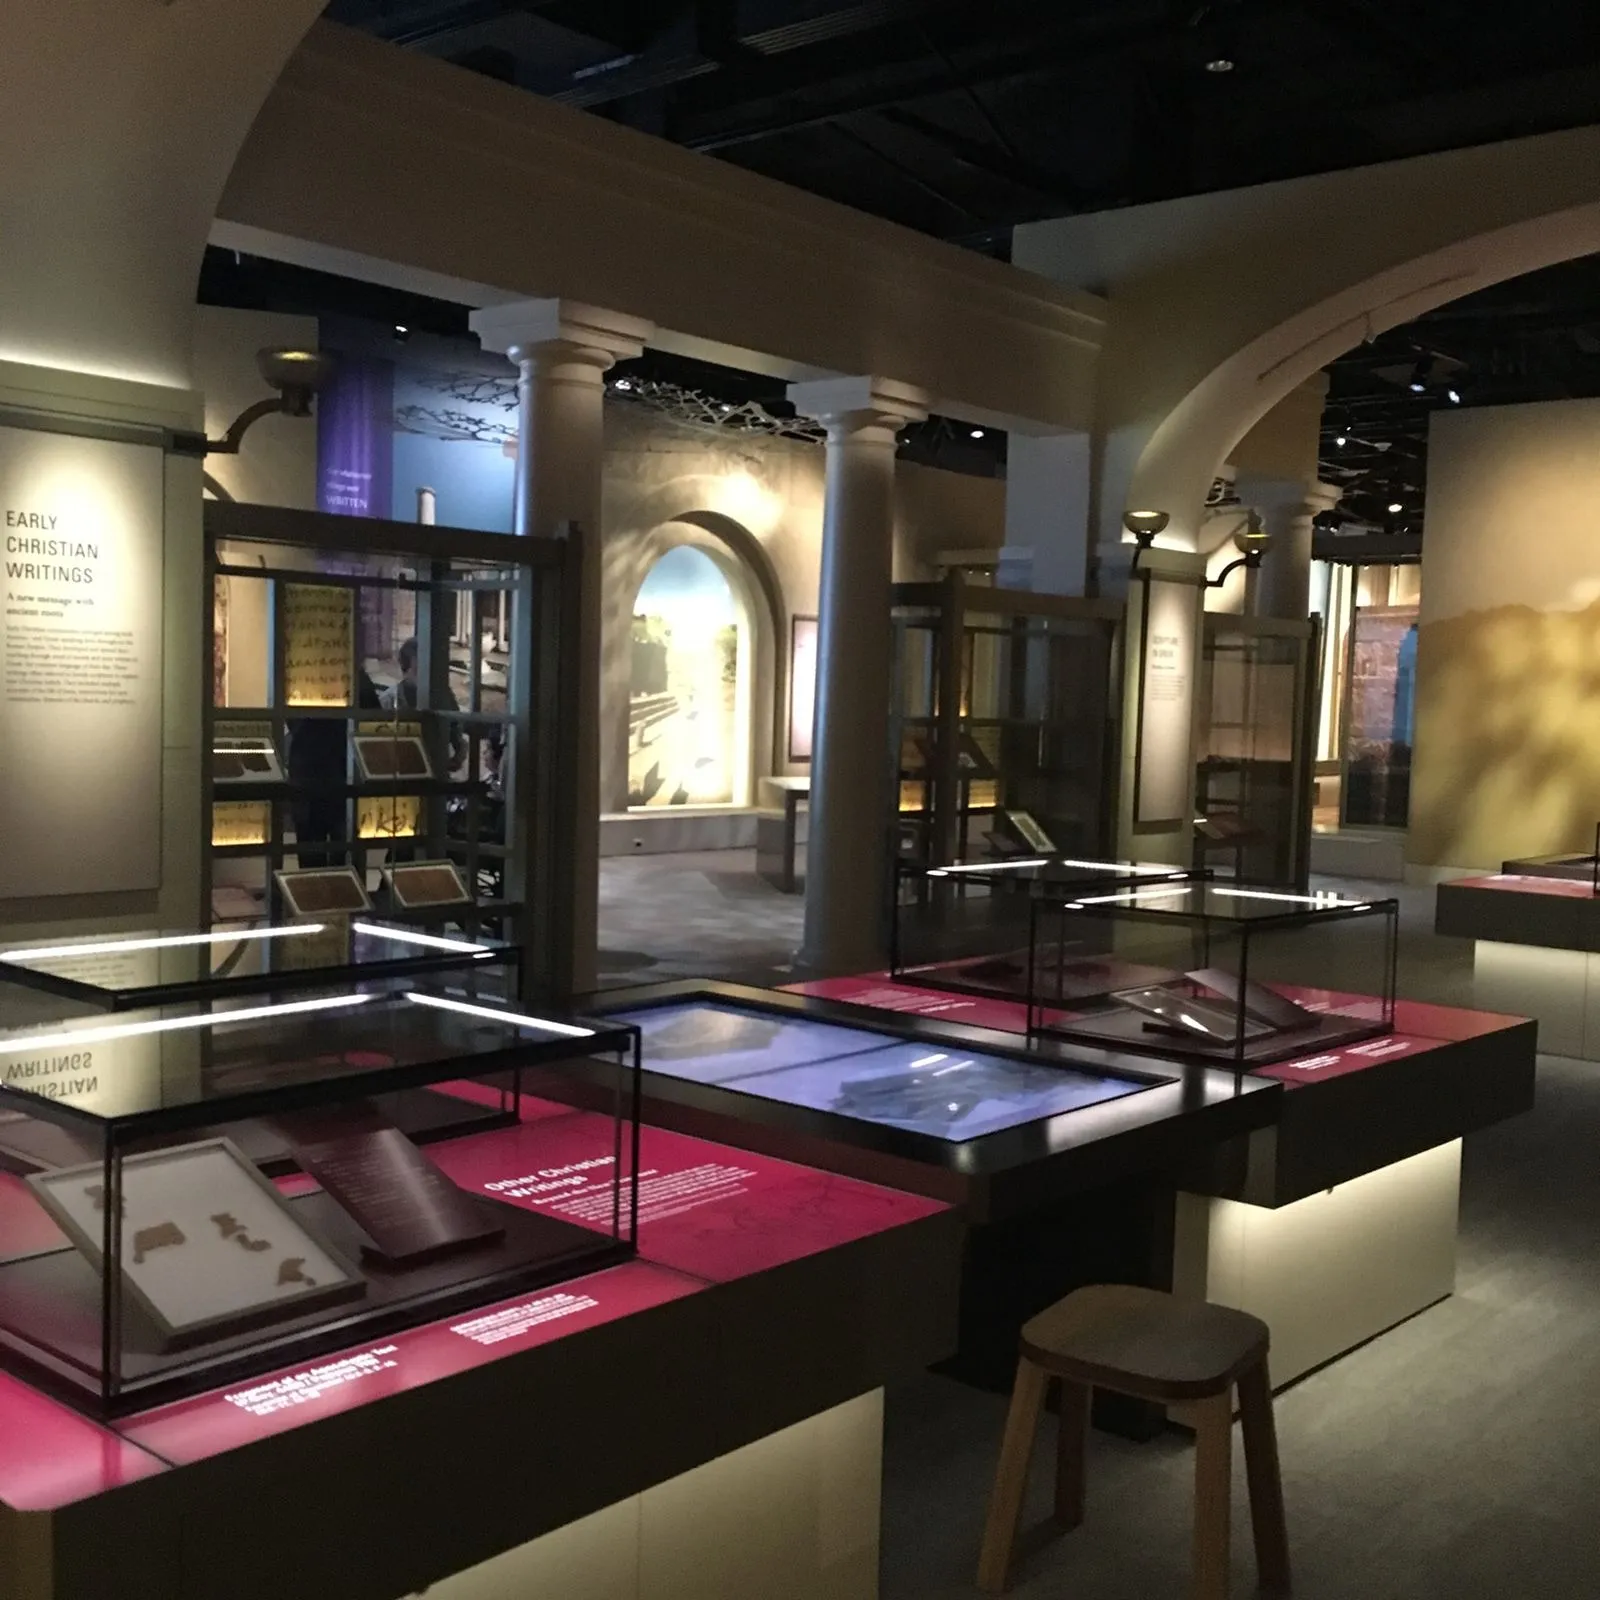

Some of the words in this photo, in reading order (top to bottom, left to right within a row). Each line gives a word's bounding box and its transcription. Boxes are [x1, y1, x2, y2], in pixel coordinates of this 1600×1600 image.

[6, 510, 57, 530] EARLY
[6, 536, 99, 559] CHRISTIAN
[6, 562, 94, 584] WRITINGS
[484, 1174, 540, 1191] Other
[503, 1175, 588, 1198] Writings
